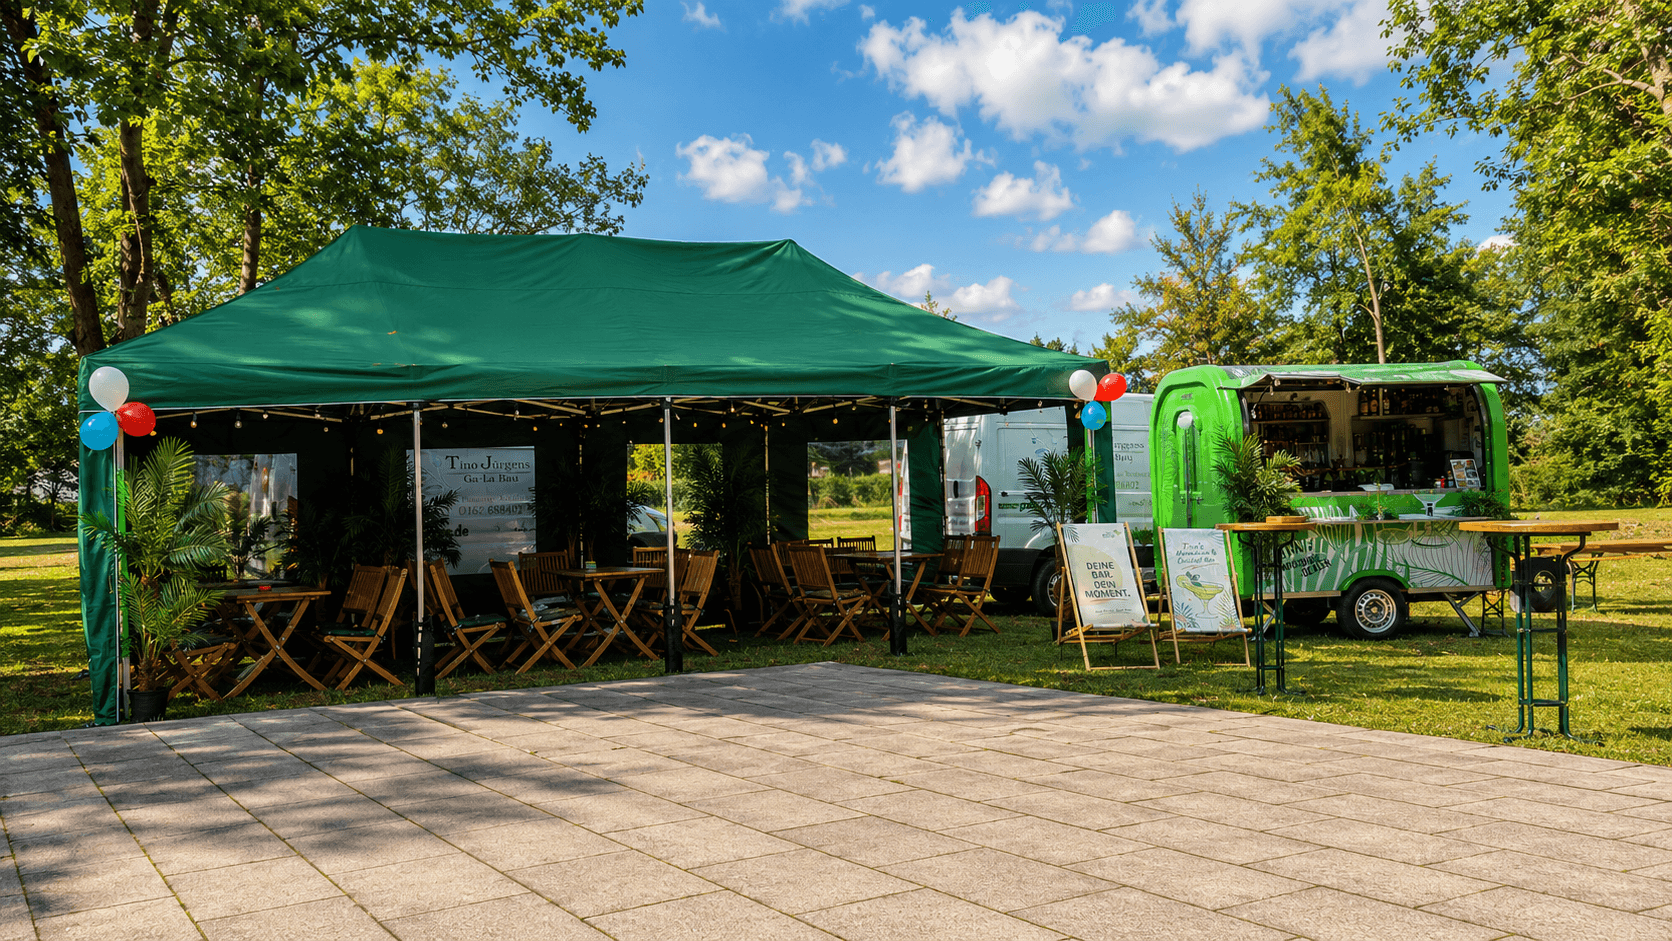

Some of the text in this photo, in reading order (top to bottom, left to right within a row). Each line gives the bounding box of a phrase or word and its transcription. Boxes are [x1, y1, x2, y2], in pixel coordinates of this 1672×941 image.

[445, 455, 478, 470] Tino
[1086, 561, 1115, 570] DEINE
[1093, 580, 1116, 589] DEIN
[1084, 589, 1131, 598] MOMENT.
